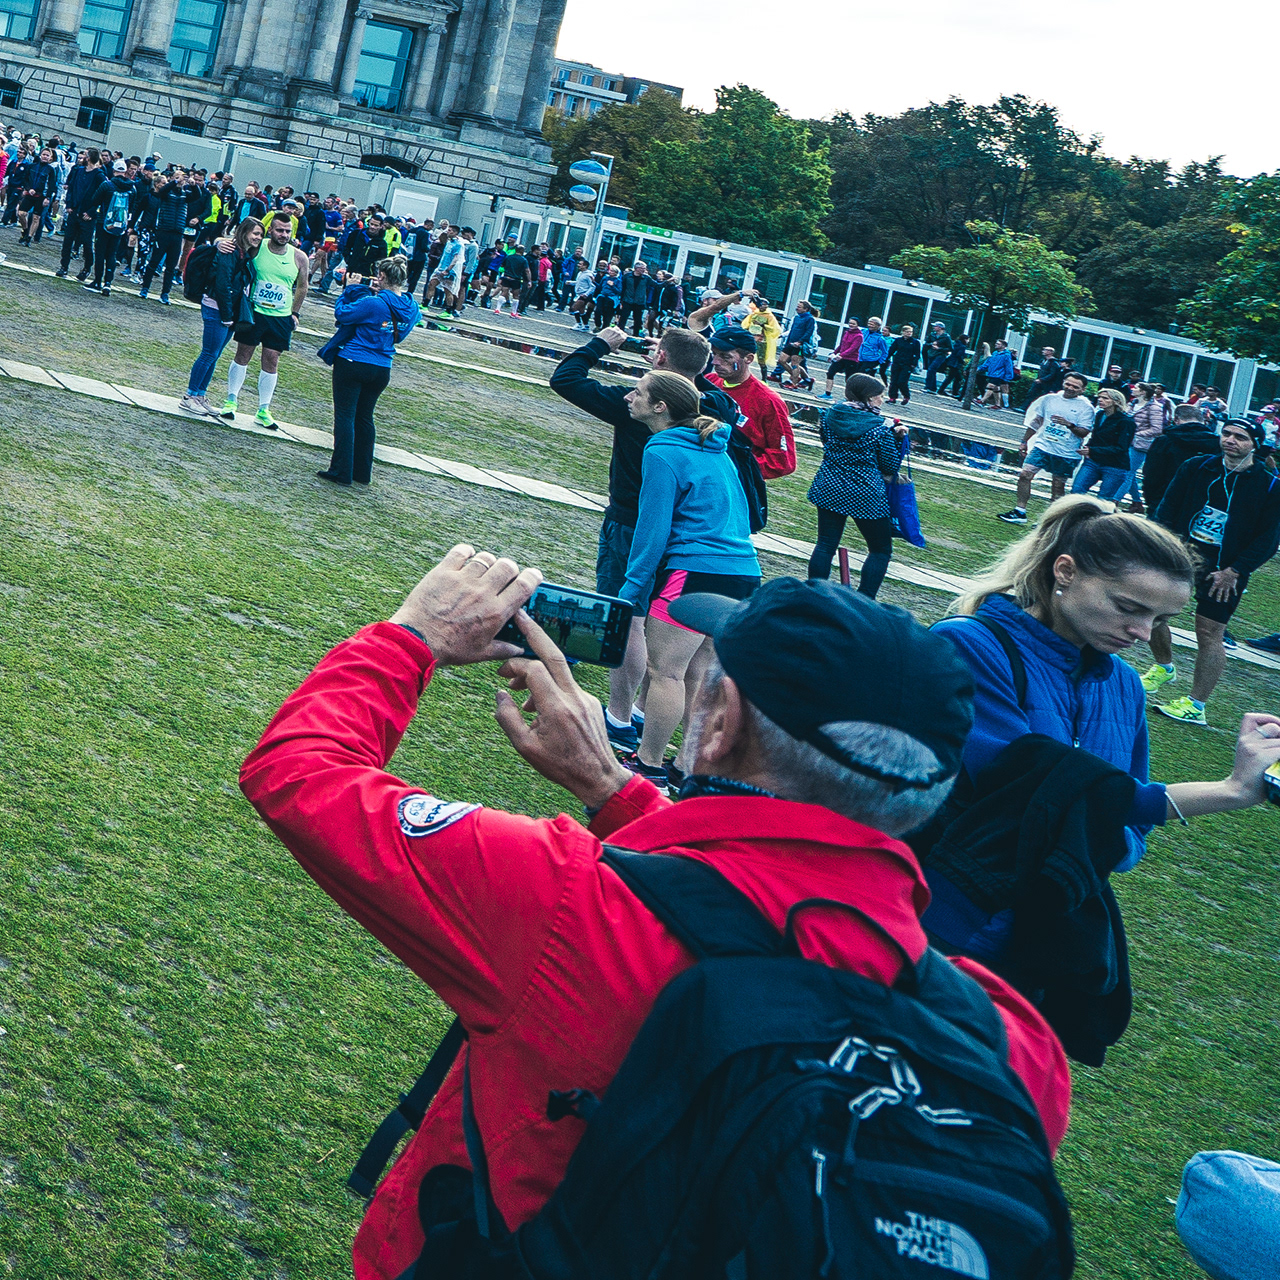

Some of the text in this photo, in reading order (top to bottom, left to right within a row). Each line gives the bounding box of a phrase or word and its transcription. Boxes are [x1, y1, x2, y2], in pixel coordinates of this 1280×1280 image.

[258, 288, 283, 302] 52010
[874, 1217, 952, 1251] NORTH
[905, 1210, 951, 1235] THE
[896, 1239, 954, 1268] FACE
